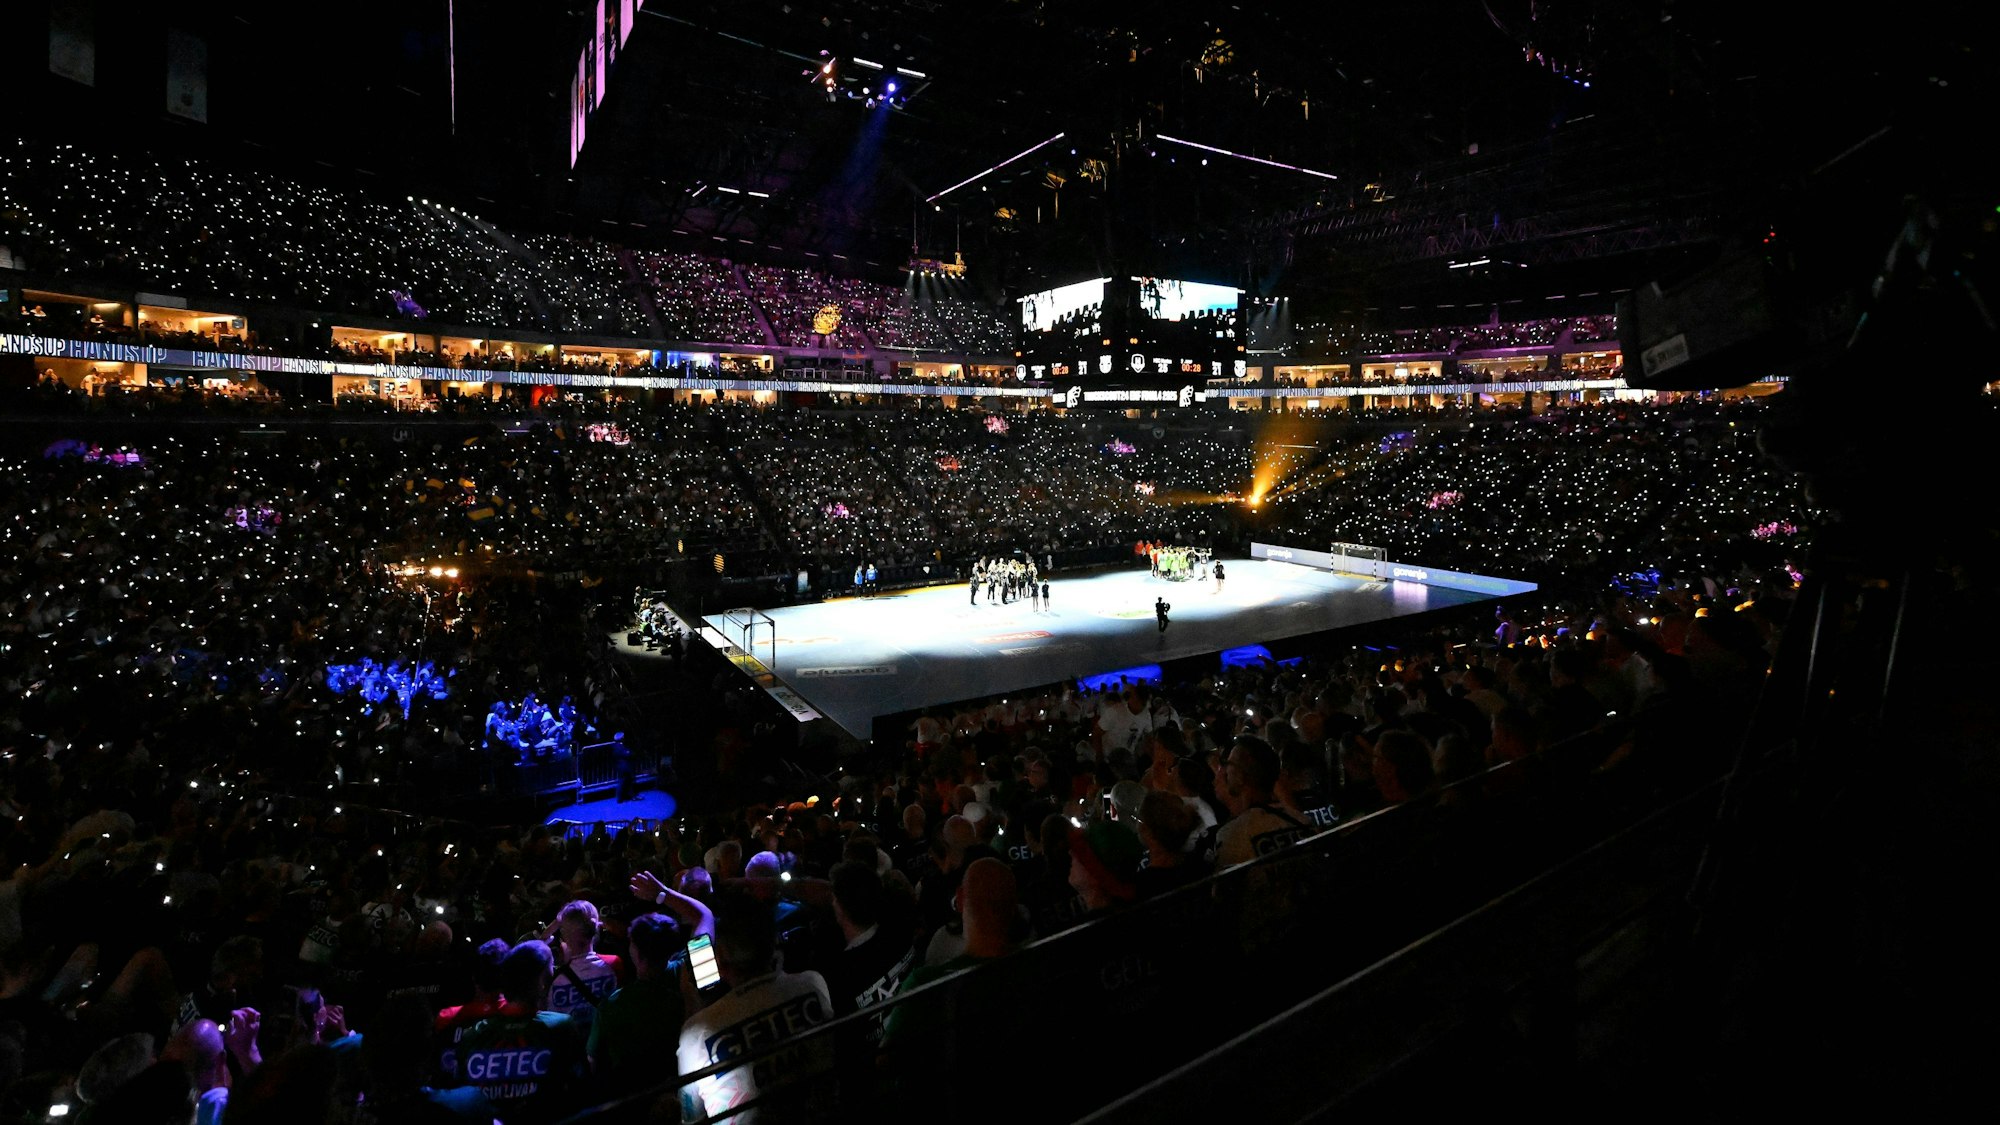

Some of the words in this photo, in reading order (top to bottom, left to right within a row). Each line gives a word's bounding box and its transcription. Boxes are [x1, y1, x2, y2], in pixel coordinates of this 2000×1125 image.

[1266, 548, 1293, 560] gorenje
[1393, 567, 1428, 580] gorenje
[707, 997, 825, 1067] GETEC
[467, 1049, 552, 1080] GETEC
